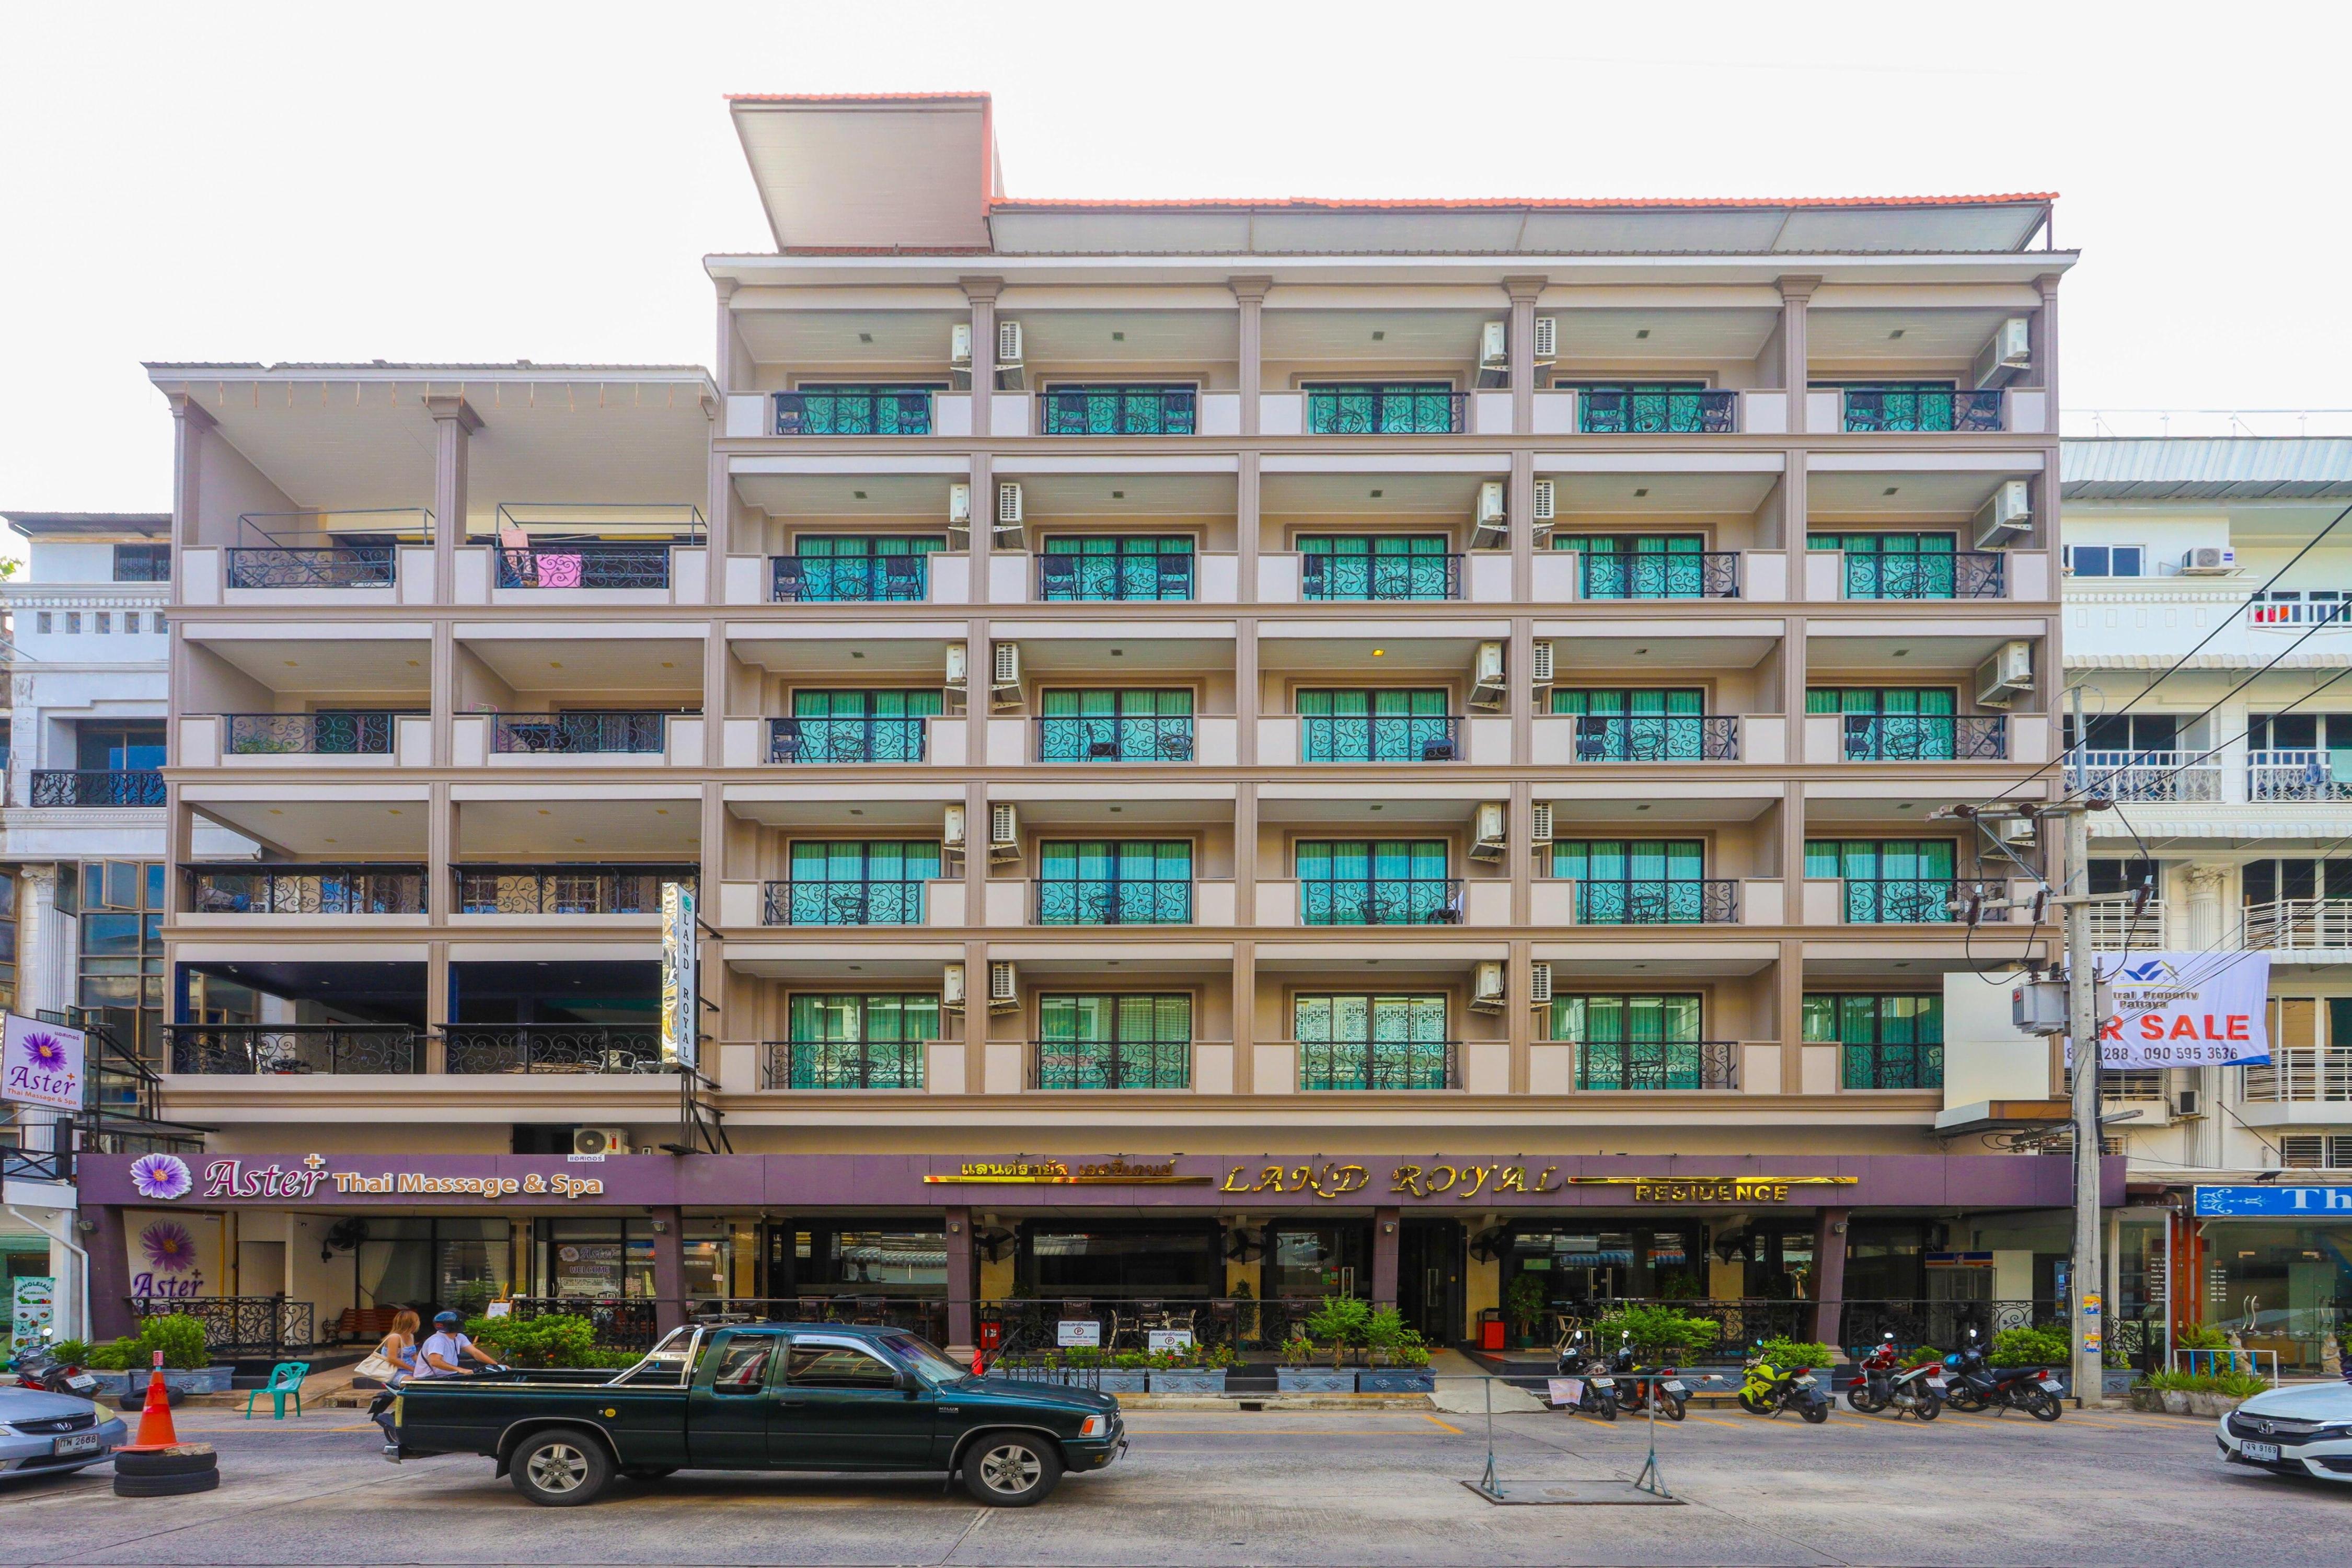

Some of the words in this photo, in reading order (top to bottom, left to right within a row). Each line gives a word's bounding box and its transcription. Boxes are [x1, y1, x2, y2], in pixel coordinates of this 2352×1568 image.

[2143, 991, 2199, 1000] Property
[2119, 1000, 2168, 1009] Pattaya
[2140, 1014, 2250, 1041] SALE
[2144, 1047, 2170, 1059] 090
[2176, 1046, 2201, 1059] 595
[2207, 1047, 2238, 1059] 3636
[9, 1066, 76, 1096] Aster
[25, 1091, 56, 1102] Massage
[204, 1160, 328, 1197] Aster
[332, 1172, 394, 1193] Thai
[398, 1173, 520, 1198] Massage
[523, 1173, 548, 1193] &
[551, 1174, 604, 1198] Spa
[1218, 1163, 1369, 1198] LAND
[1390, 1165, 1562, 1197] ROYAL
[1635, 1185, 1789, 1201] RESIDENCE
[17, 1282, 52, 1293] WHOLESALE
[133, 1272, 204, 1297] Aster
[75, 1435, 96, 1445] 2668
[2259, 1445, 2276, 1453] 9169
